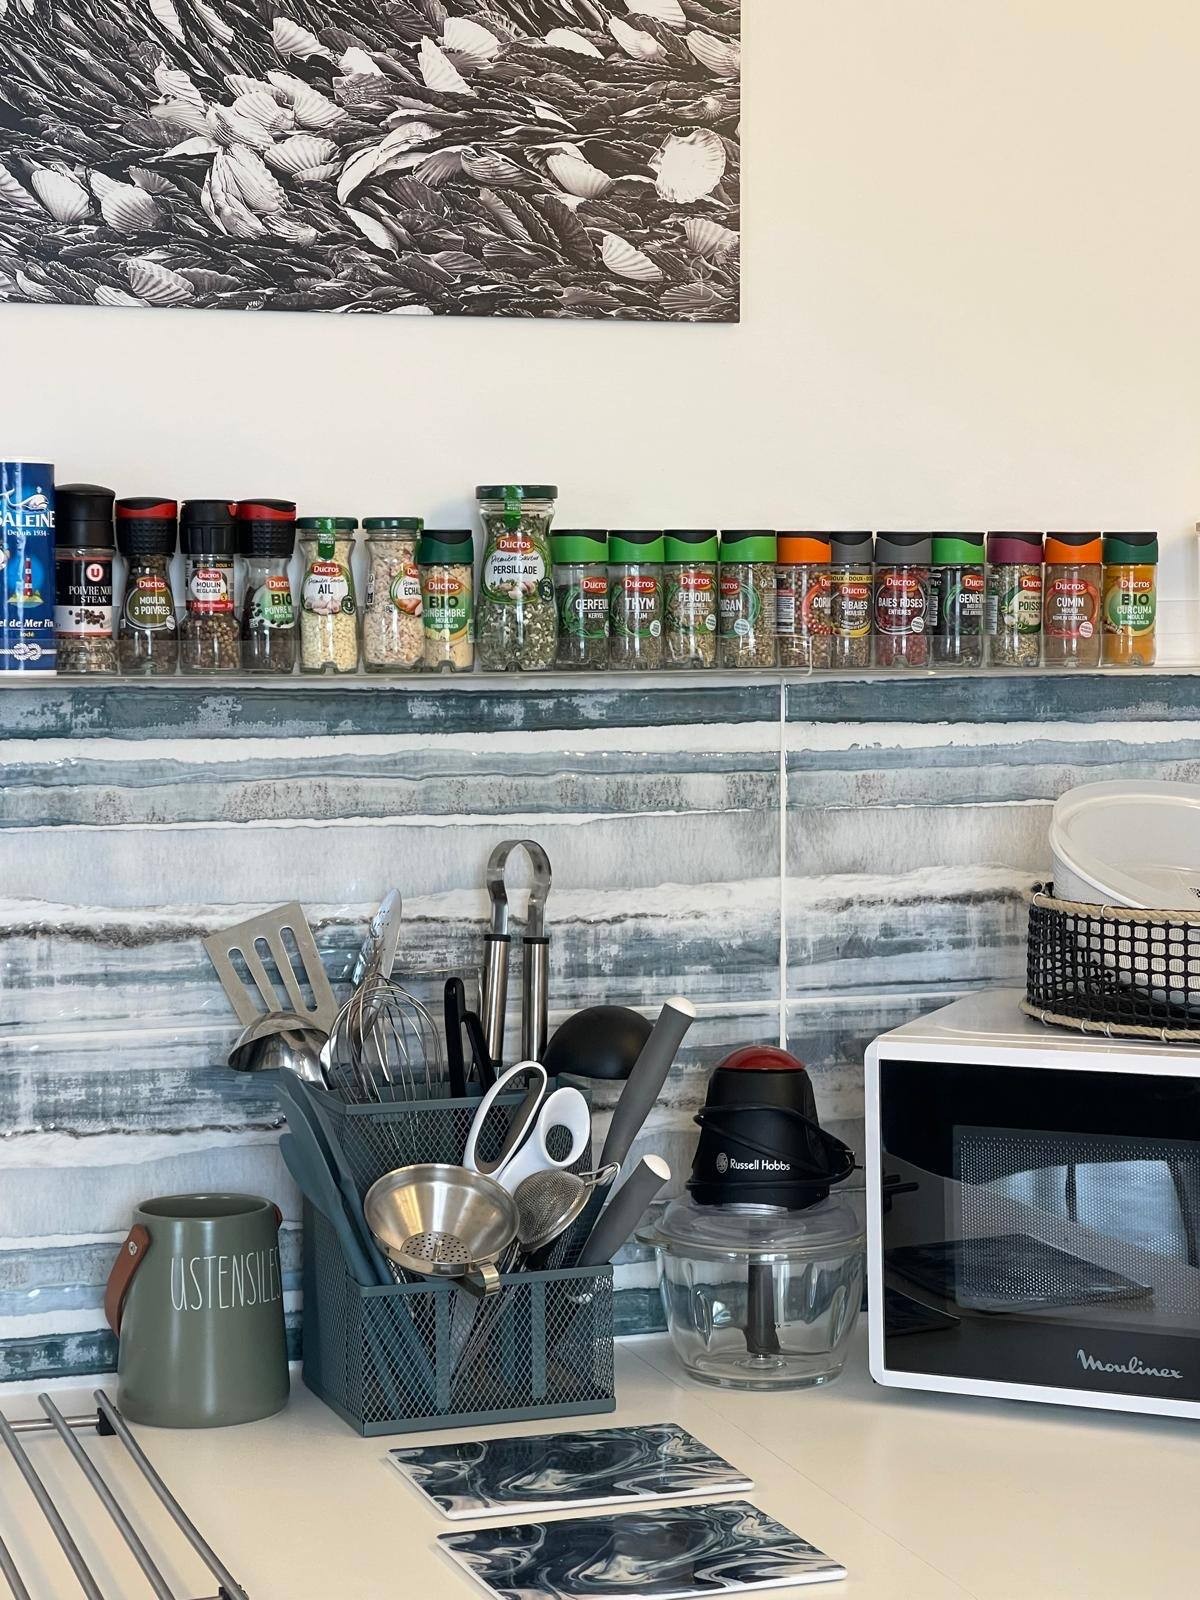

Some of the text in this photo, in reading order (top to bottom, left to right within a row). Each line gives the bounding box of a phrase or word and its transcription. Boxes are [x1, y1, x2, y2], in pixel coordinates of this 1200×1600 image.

[500, 540, 531, 549] Ducros
[90, 568, 100, 578] U
[313, 565, 339, 573] Ducros
[493, 565, 538, 575] PERSILLADE
[625, 579, 654, 588] Ducros
[680, 576, 710, 585] Ducros
[886, 578, 916, 586] Ducros
[1120, 580, 1150, 588] Ducros
[69, 585, 100, 595] POIVRE
[317, 583, 334, 595] AIL
[428, 581, 459, 590] Ducros
[841, 586, 867, 594] Ducros
[1055, 581, 1085, 590] Ducros
[80, 595, 107, 604] STEAK
[139, 596, 166, 605] MOULIN
[271, 593, 292, 605] BIO
[678, 592, 712, 602] FENOUIL
[1121, 593, 1149, 605] BIO
[429, 596, 458, 608] BIO
[625, 597, 655, 610] THYM
[848, 600, 868, 610] BAIES
[878, 597, 923, 608] BAIES ROSES
[1056, 597, 1084, 607] CUMIN
[134, 606, 171, 615] 3 POIVRES
[1117, 606, 1152, 614] CURCUMA
[9, 619, 21, 628] de
[23, 619, 42, 628] Mer
[730, 1158, 791, 1171] Russell Hobbs
[1076, 1349, 1184, 1379] Moulinex
